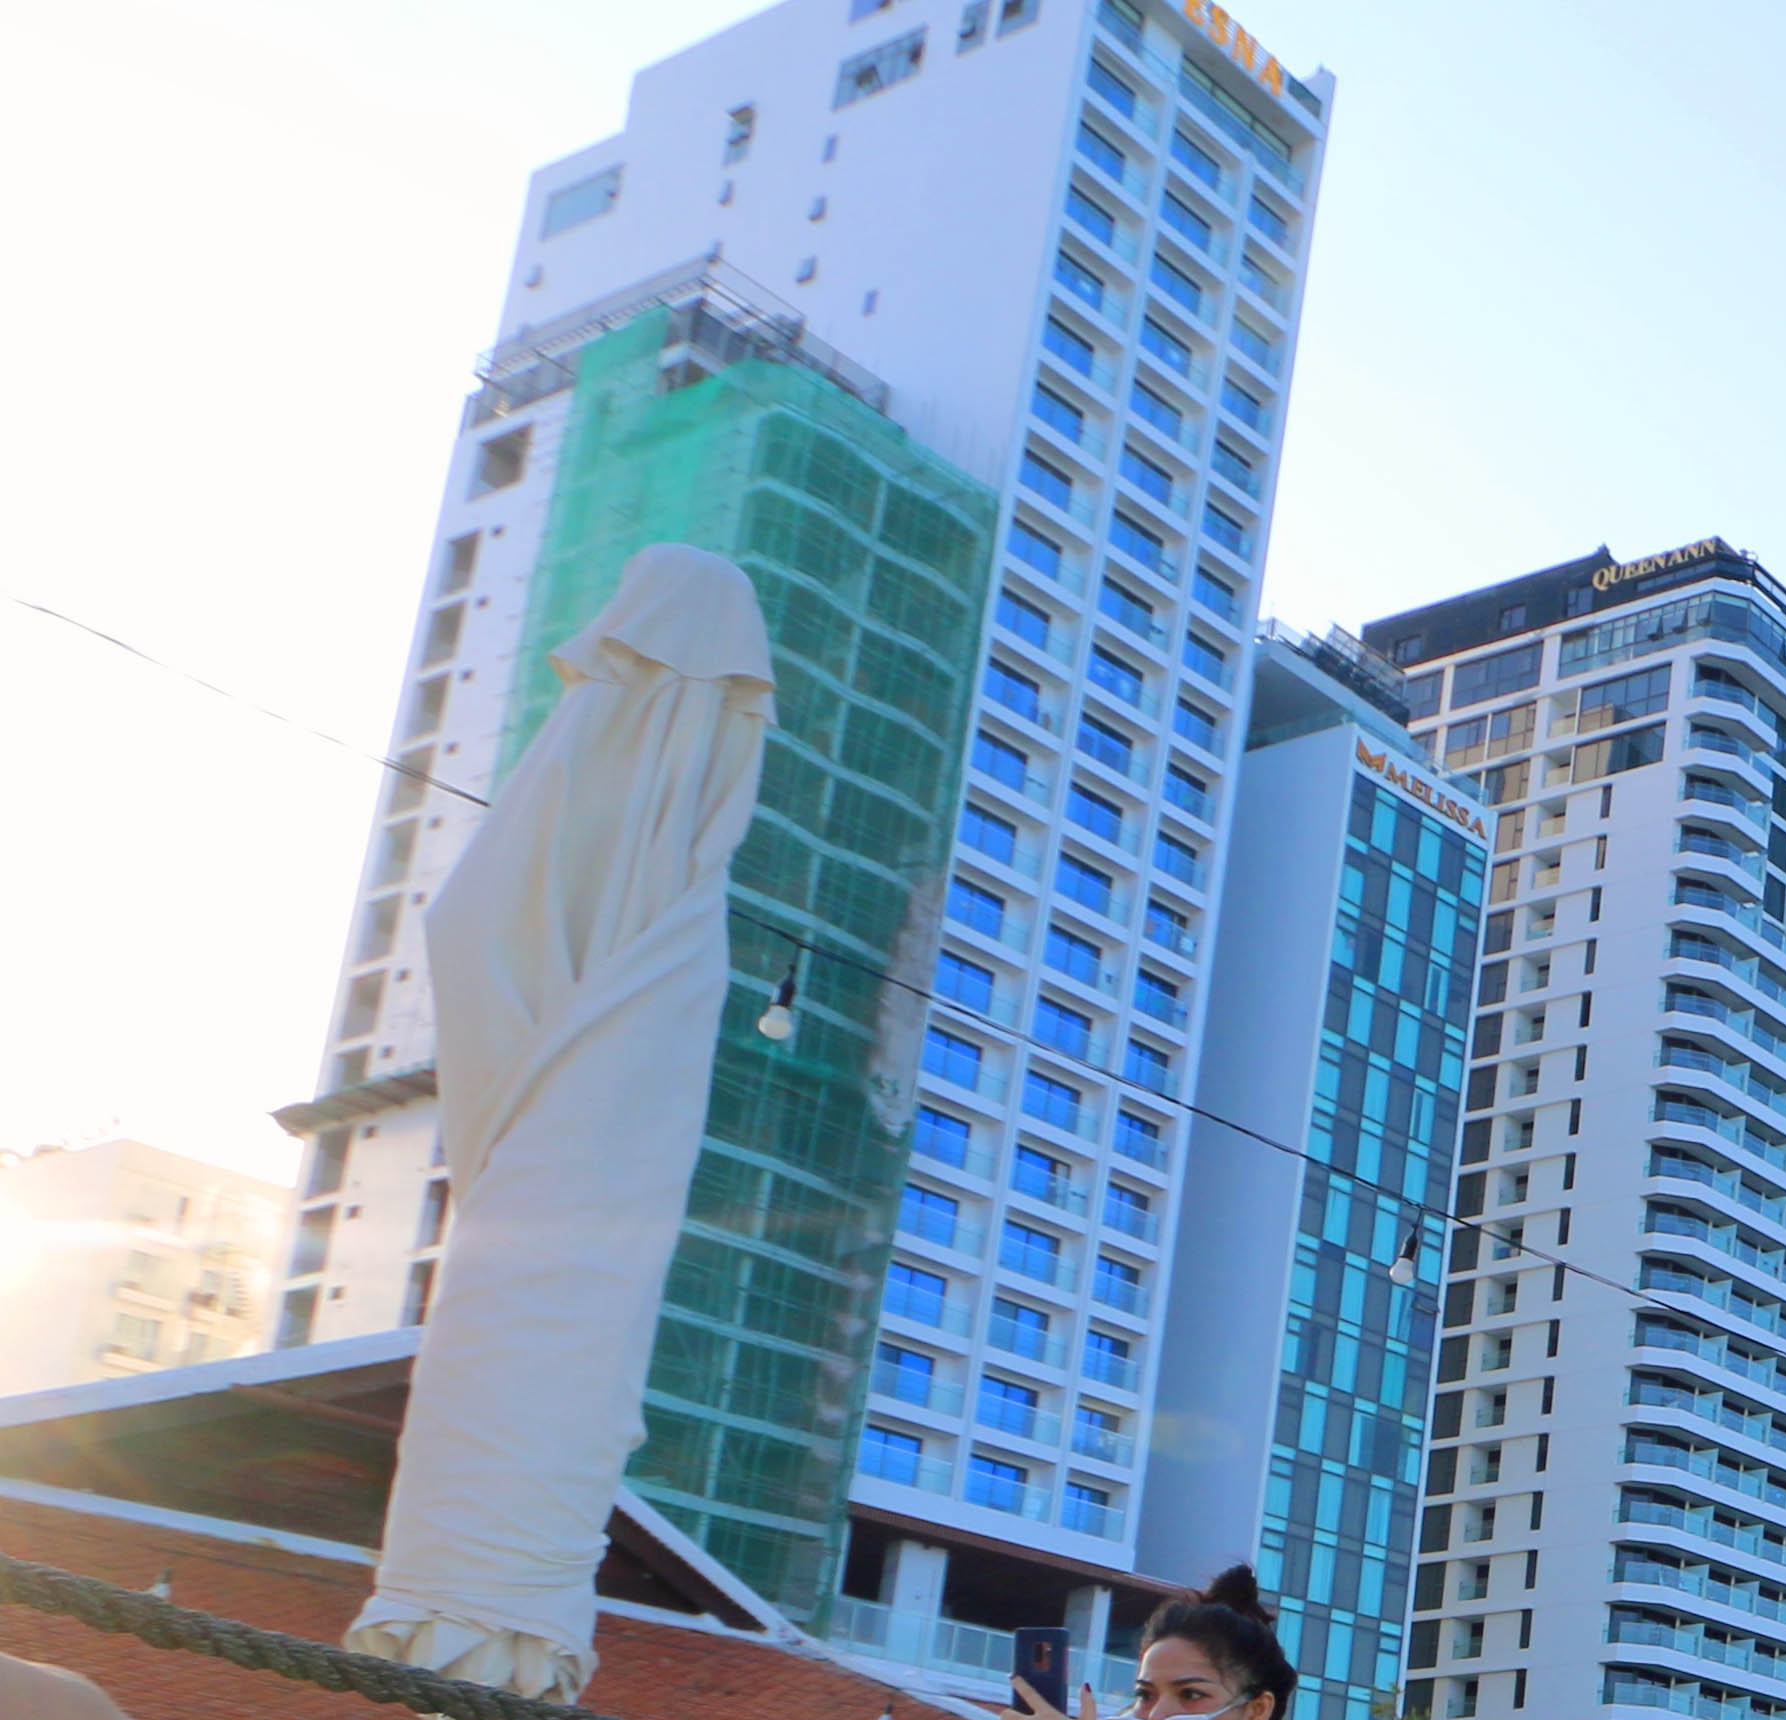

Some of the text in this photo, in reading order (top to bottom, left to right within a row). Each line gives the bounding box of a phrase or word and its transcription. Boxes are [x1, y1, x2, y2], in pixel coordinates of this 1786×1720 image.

[1592, 540, 1717, 591] QUEEN ANN
[1384, 761, 1487, 840] MELISSA
